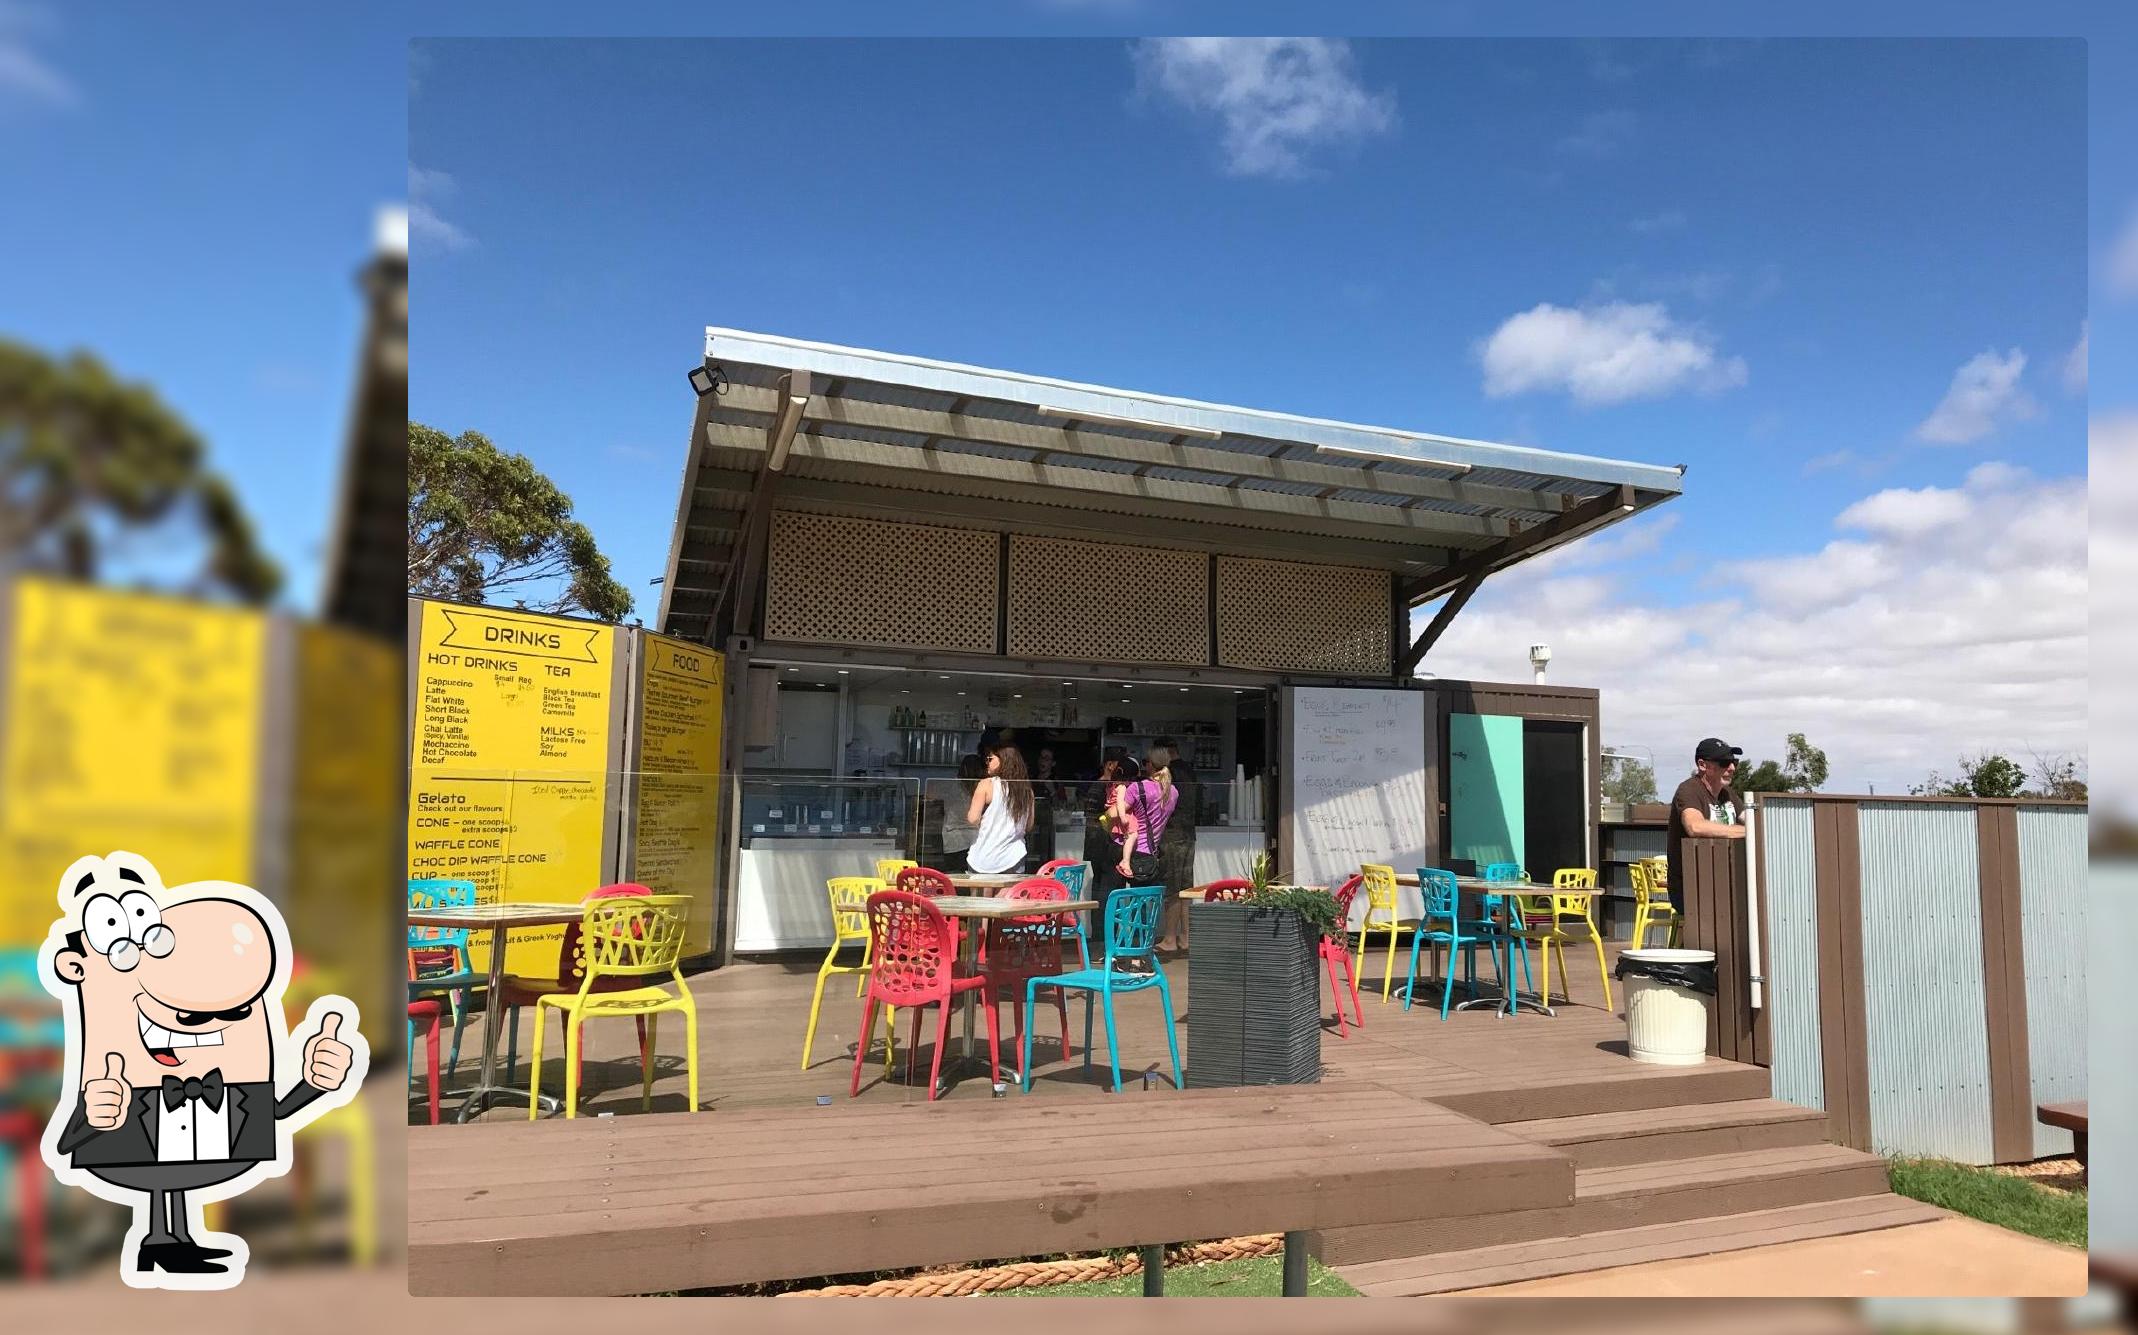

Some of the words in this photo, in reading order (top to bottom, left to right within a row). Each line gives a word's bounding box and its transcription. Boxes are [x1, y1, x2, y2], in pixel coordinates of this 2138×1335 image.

[485, 626, 560, 649] DRINKS
[427, 652, 461, 666] HOT
[464, 656, 518, 672] DRINKS
[673, 654, 700, 673] FOOD
[544, 665, 571, 678] TEA
[426, 676, 473, 688] Cappuccino
[494, 674, 514, 683] Small
[425, 686, 446, 695] Latte
[543, 687, 568, 696] English
[570, 689, 601, 699] Breakfast
[425, 695, 441, 704] Flat
[443, 696, 465, 706] White
[543, 694, 562, 702] Black
[425, 704, 447, 714] Short
[449, 705, 470, 715] Black
[542, 701, 562, 709] Green
[565, 702, 576, 710] Tea
[424, 713, 445, 724] Long
[447, 715, 468, 724] Black
[424, 724, 442, 733] Chai
[444, 725, 463, 734] Latte
[540, 726, 576, 737] MILKS
[423, 739, 470, 749] Mochaccino
[540, 735, 569, 744] Lactose
[570, 736, 586, 745] Free
[540, 742, 554, 751] Soy
[422, 748, 437, 756] Hot
[438, 748, 478, 758] Chocolate
[540, 749, 568, 758] Almond
[421, 756, 446, 764] Decaf
[417, 792, 466, 804] Gelato
[417, 804, 442, 812] Check
[473, 805, 503, 813] flavours
[416, 818, 450, 828] CONE
[482, 826, 508, 834] scoops
[415, 839, 465, 850] WAFFLE
[467, 838, 500, 849] CONE
[413, 857, 446, 867] CHOC
[448, 856, 468, 866] DIP
[470, 854, 516, 866] WAFFLE
[517, 853, 547, 864] CONE
[411, 871, 438, 881] CUP
[467, 869, 490, 877] scoop
[523, 933, 544, 943] Greek
